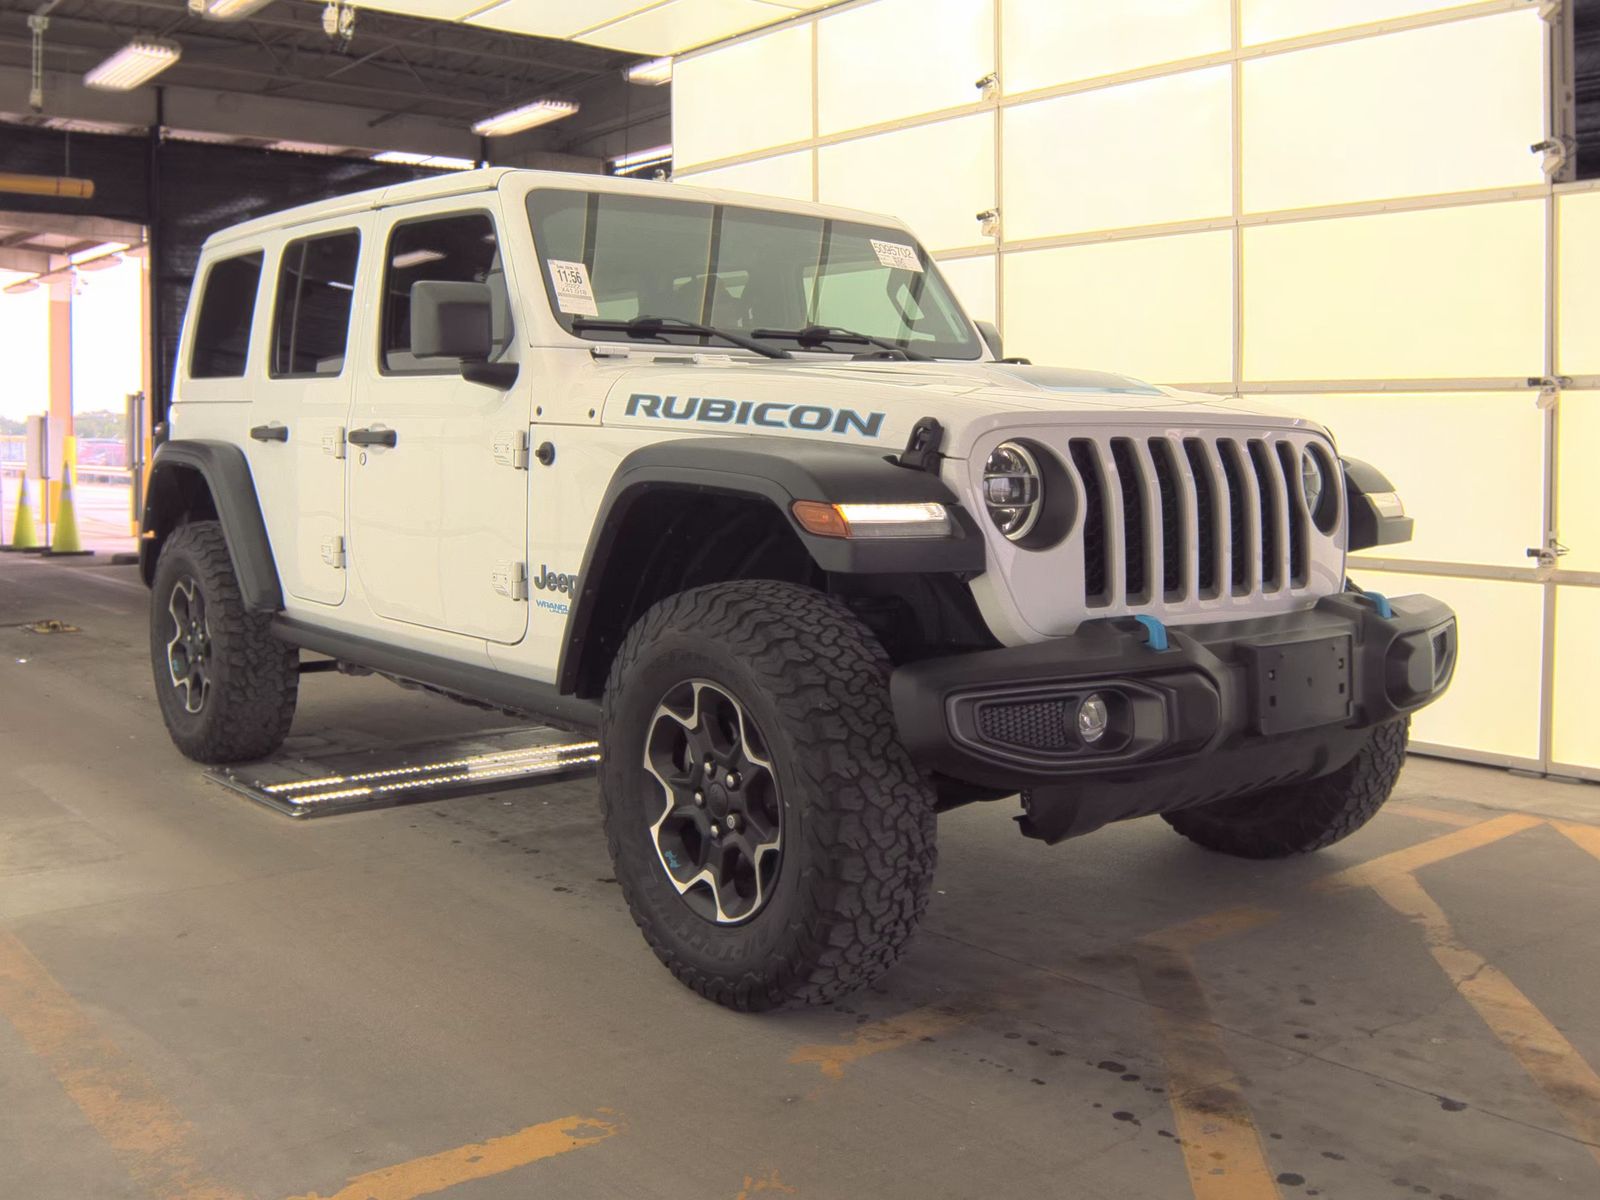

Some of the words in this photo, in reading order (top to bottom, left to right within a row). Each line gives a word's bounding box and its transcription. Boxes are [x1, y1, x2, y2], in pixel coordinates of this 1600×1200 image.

[557, 269, 583, 284] 11:56
[624, 393, 887, 438] RUBICON
[534, 564, 578, 599] Jeep
[535, 599, 569, 611] WRANGL
